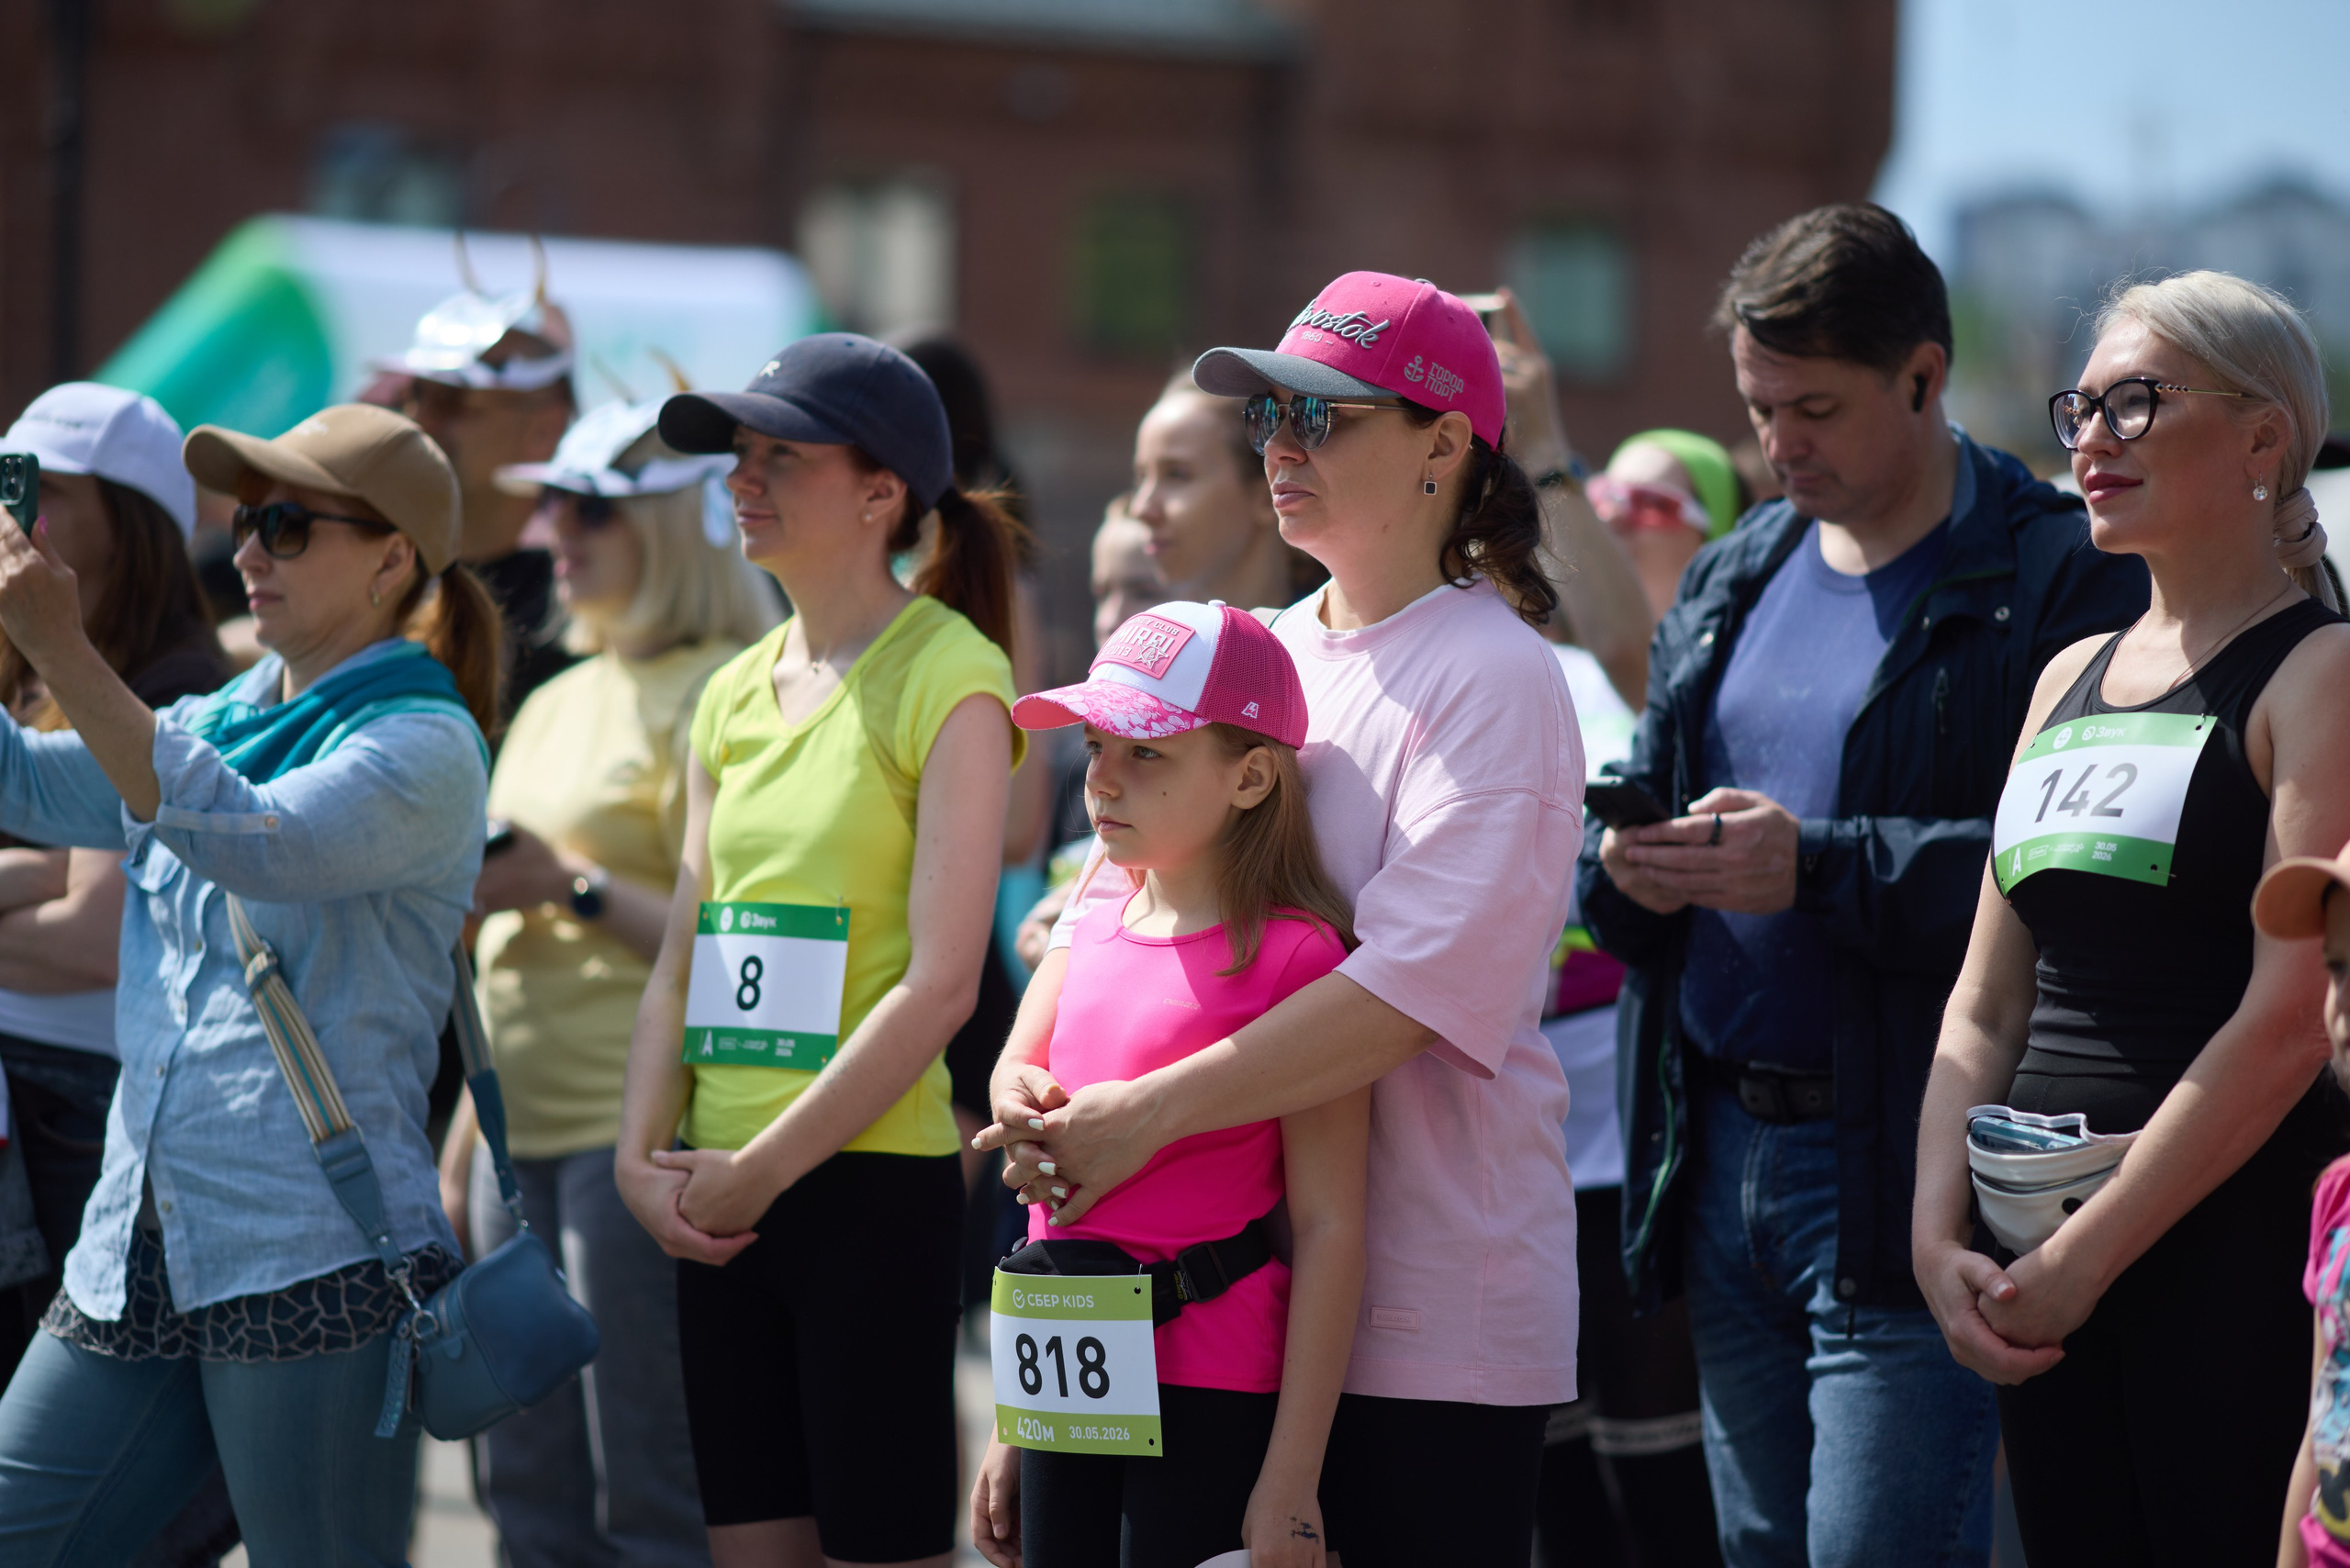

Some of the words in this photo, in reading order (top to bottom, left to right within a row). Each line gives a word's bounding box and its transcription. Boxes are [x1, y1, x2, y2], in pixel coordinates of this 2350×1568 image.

[1301, 330, 1323, 342] 1860
[1428, 362, 1464, 394] ГОРОД
[1425, 375, 1457, 402] ПОРТ
[1154, 622, 1181, 636] CLUB
[2095, 725, 2127, 739] Звук
[2034, 762, 2138, 823] 142
[2095, 841, 2117, 852] 30.05
[2092, 851, 2112, 861] 2026
[736, 955, 763, 1011] 8
[1027, 1294, 1059, 1307] СБЕР
[1062, 1294, 1094, 1308] KIDS
[1015, 1333, 1110, 1399] 818
[1069, 1426, 1130, 1440] 30.05.2026
